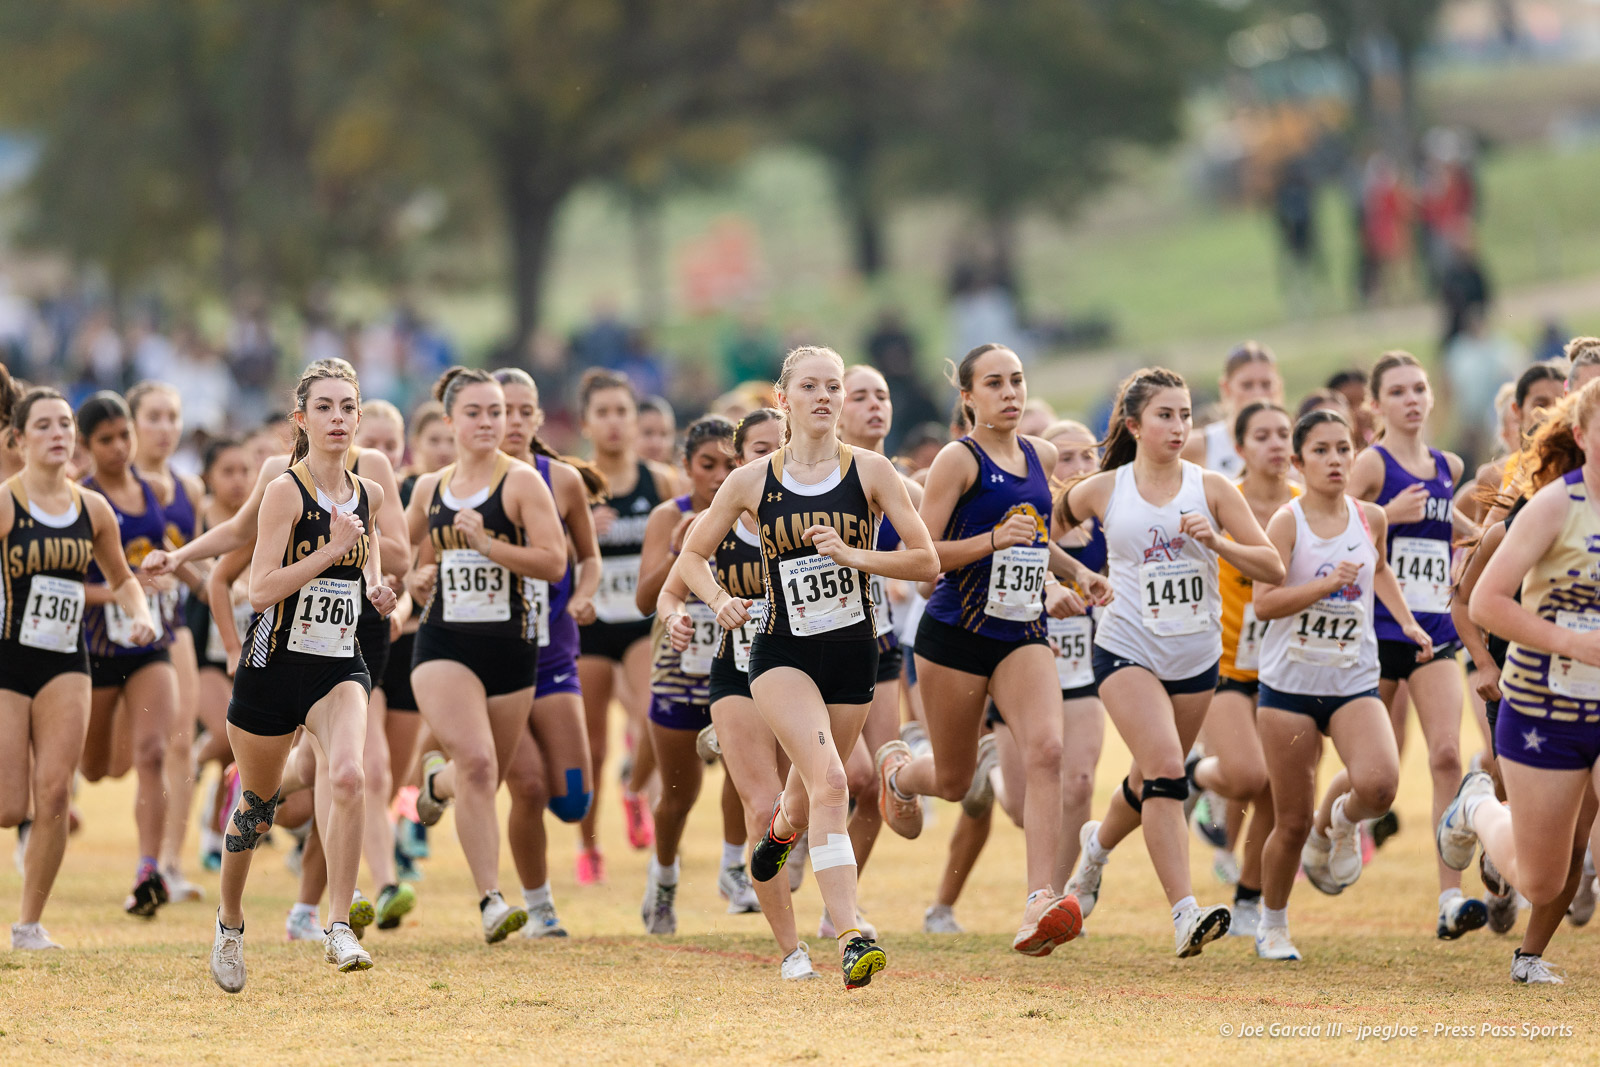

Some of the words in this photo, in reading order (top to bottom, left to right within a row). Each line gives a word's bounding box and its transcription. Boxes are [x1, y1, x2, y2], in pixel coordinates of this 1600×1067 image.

[800, 562, 838, 574] Champions
[809, 555, 832, 565] Region
[1397, 555, 1446, 583] 1443
[447, 567, 503, 592] 1363
[717, 562, 766, 597] SAN
[787, 567, 855, 606] 1358
[995, 564, 1044, 592] 1356
[1146, 576, 1204, 606] 1410
[31, 594, 79, 624] 1361
[299, 594, 355, 626] 1360
[1297, 612, 1358, 641] 1412
